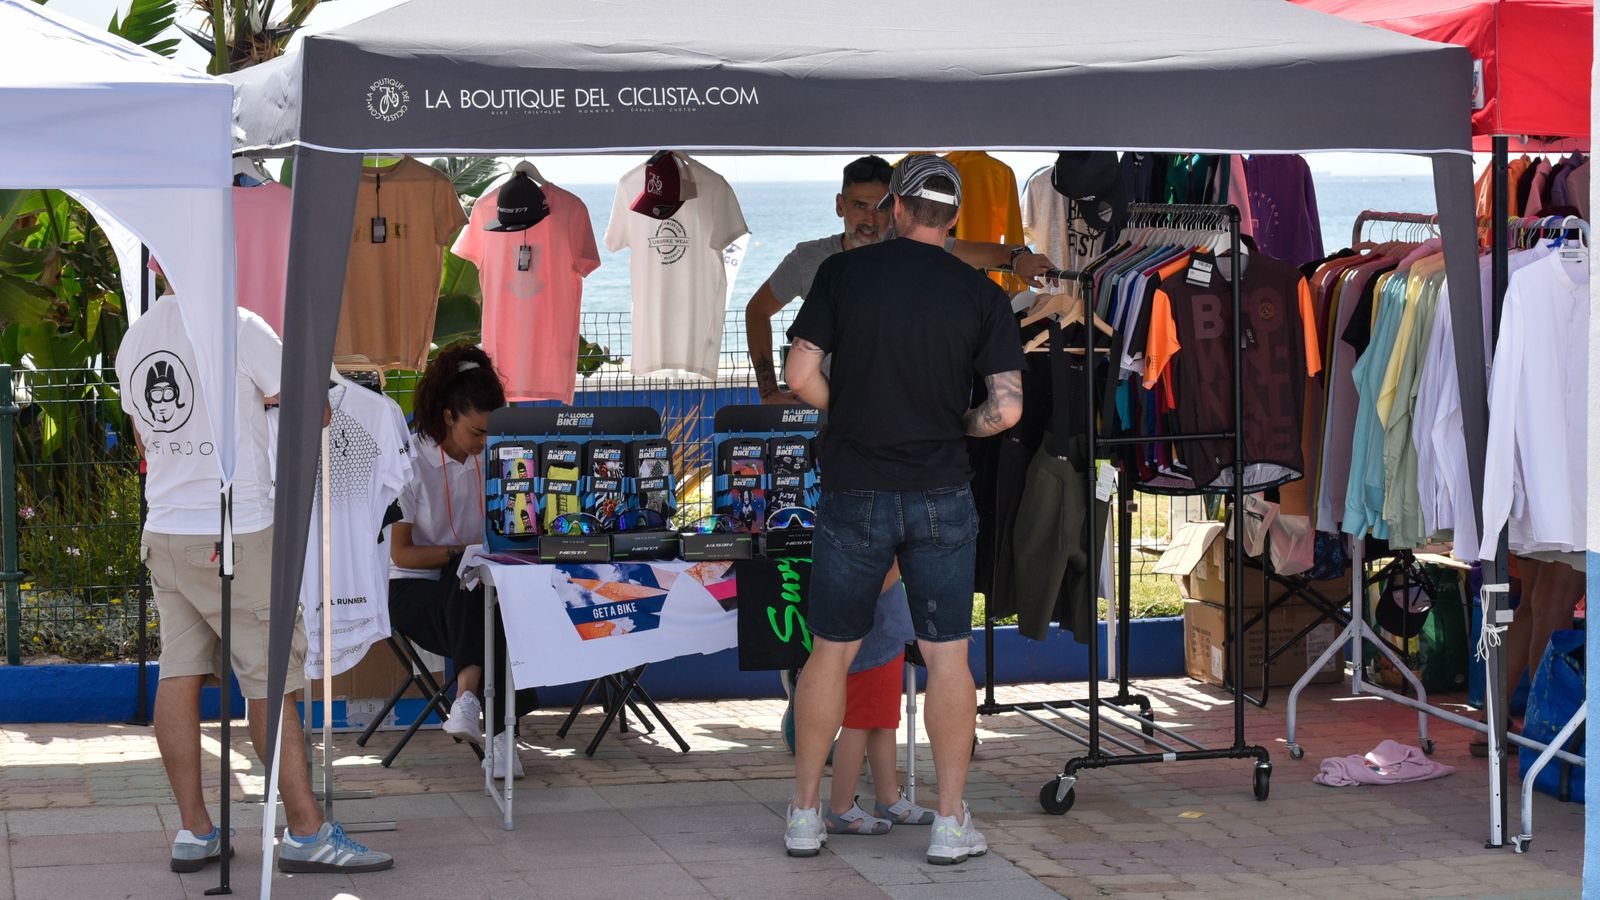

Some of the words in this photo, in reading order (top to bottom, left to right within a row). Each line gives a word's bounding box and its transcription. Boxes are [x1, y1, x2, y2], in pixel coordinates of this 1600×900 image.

[370, 77, 405, 91] BOUTIQUE
[401, 90, 410, 103] DEL
[425, 89, 451, 108] LA
[460, 88, 565, 109] BOUTIQUE
[575, 88, 610, 107] DEL
[618, 86, 759, 106] CICLISTA.COM
[556, 418, 579, 426] BIKE
[781, 415, 804, 423] BIKE
[337, 596, 368, 606] RUNNERS
[592, 606, 609, 619] GET
[610, 606, 617, 617] A
[617, 602, 638, 615] BIKE
